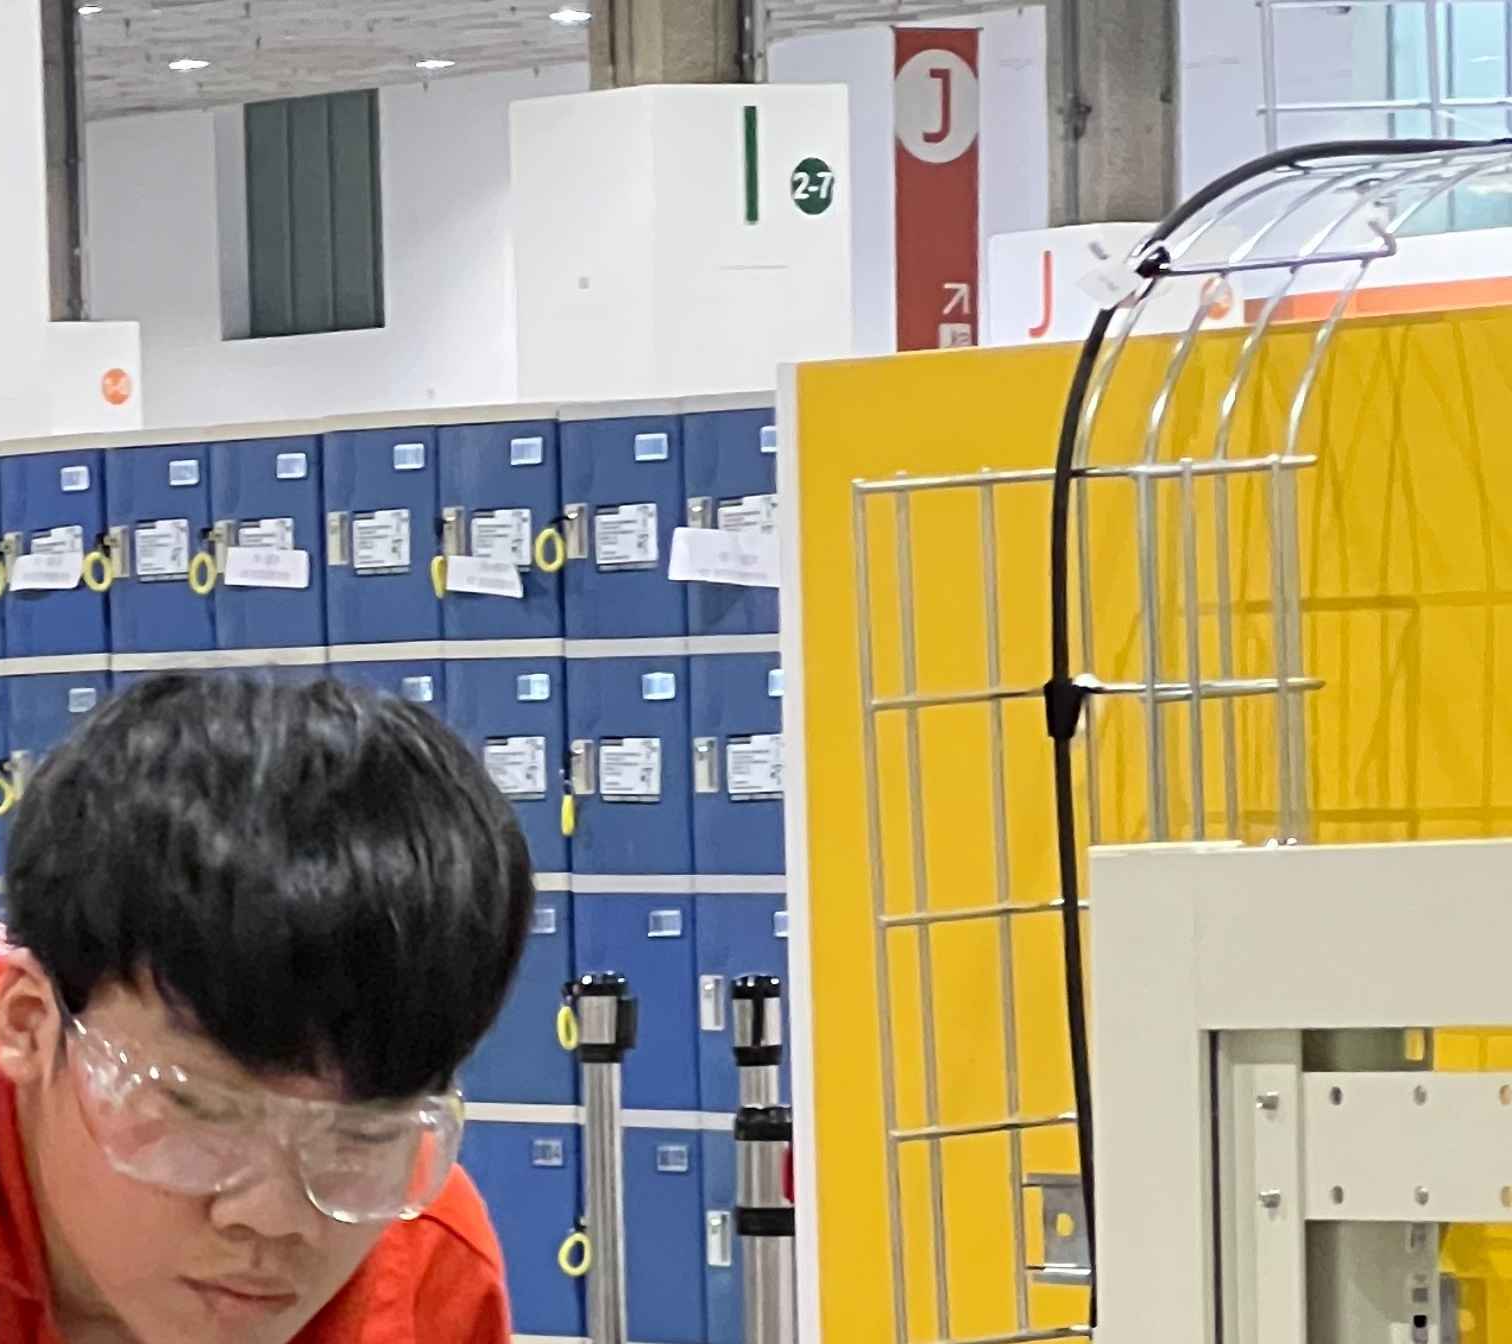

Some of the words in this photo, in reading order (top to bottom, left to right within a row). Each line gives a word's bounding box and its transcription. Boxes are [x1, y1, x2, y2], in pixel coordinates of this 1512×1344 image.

[922, 68, 953, 144] J
[792, 171, 833, 201] 2-7
[1028, 250, 1053, 338] J
